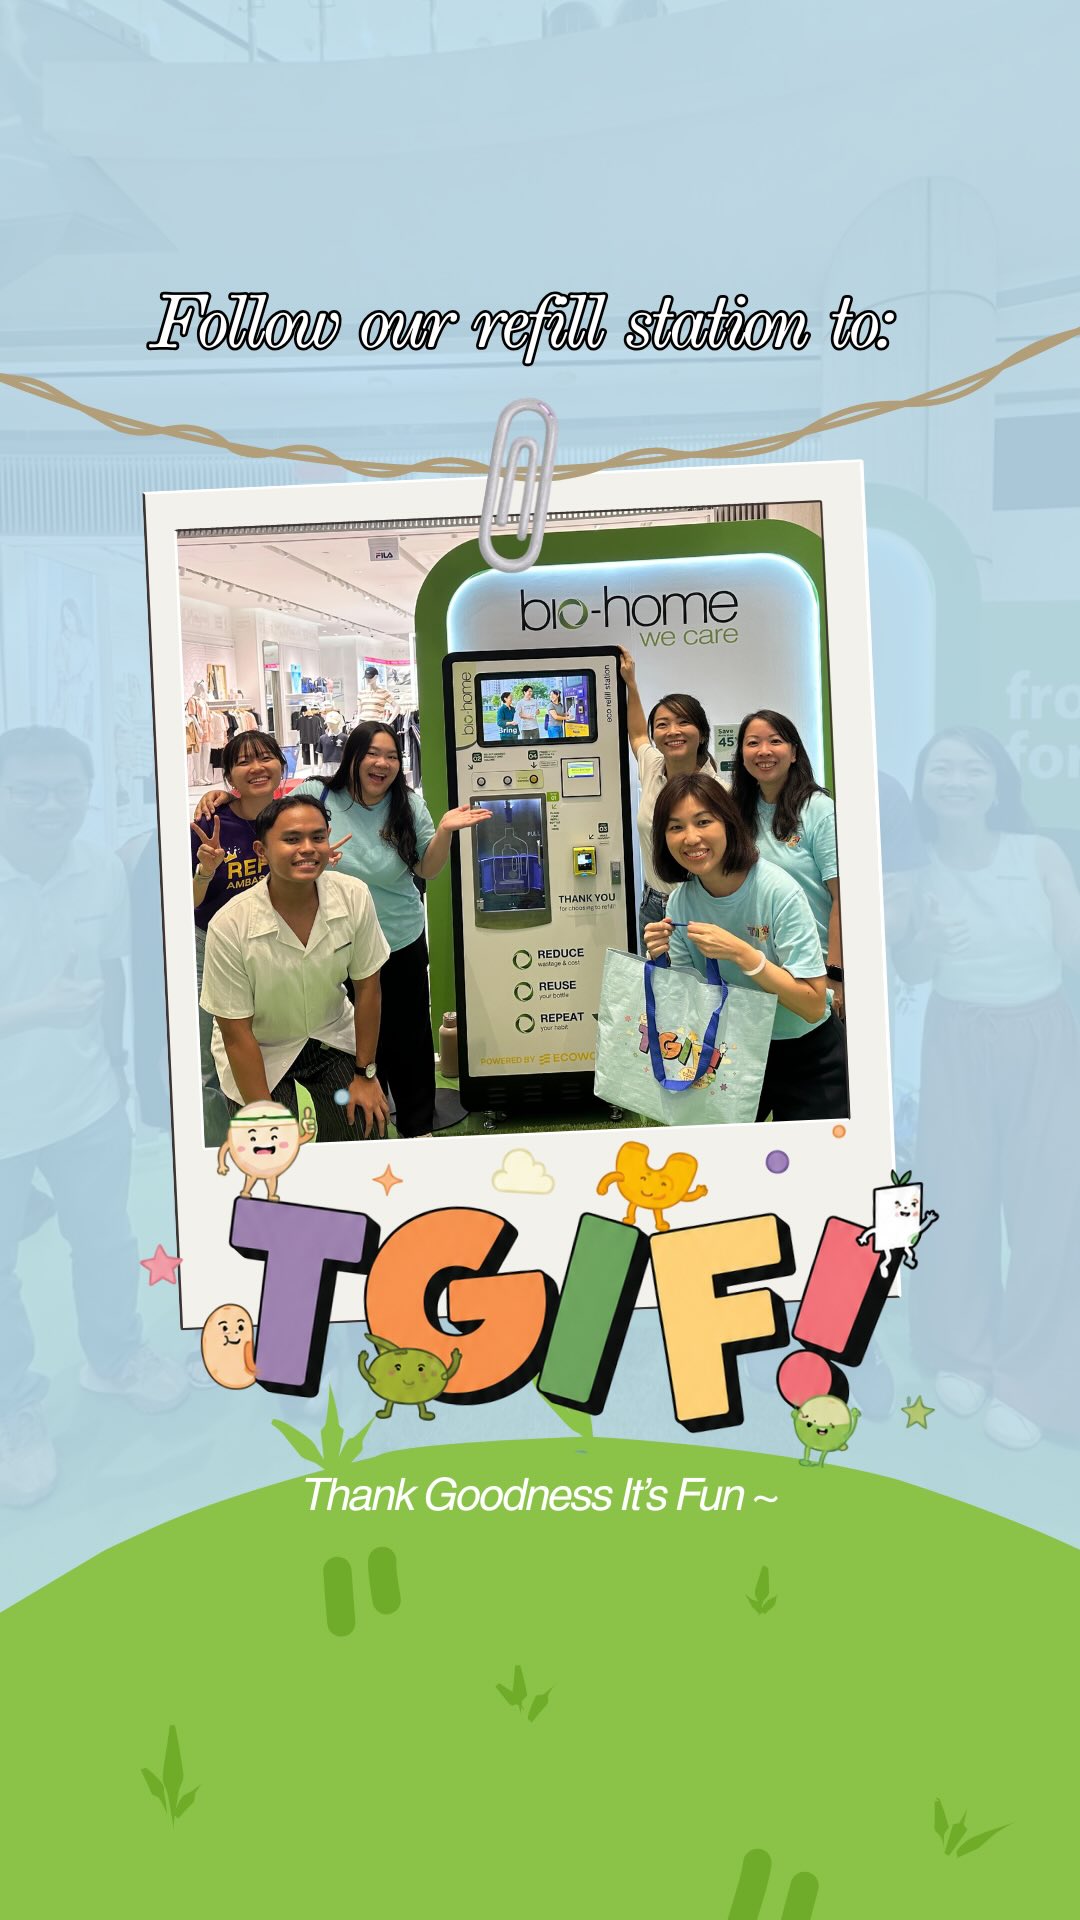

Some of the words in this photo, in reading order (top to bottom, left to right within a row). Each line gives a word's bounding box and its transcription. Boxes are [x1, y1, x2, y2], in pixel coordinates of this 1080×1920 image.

[375, 551, 394, 559] FILA
[520, 585, 739, 631] bio-home
[640, 631, 676, 647] we
[683, 627, 739, 645] care
[603, 664, 611, 690] station
[461, 671, 475, 736] bio-home
[604, 691, 612, 707] refill
[498, 727, 518, 735] Bring
[718, 736, 737, 747] 45
[558, 894, 593, 904] THANK
[594, 892, 616, 902] YOU
[568, 904, 595, 912] choosing
[537, 947, 585, 960] REDUCE
[537, 960, 562, 968] wastage
[539, 980, 577, 991] REUSE
[539, 993, 552, 1001] your
[552, 991, 569, 999] bottle
[540, 1011, 585, 1023] REPEAT
[480, 1056, 522, 1065] POWERED
[523, 1055, 536, 1063] BY
